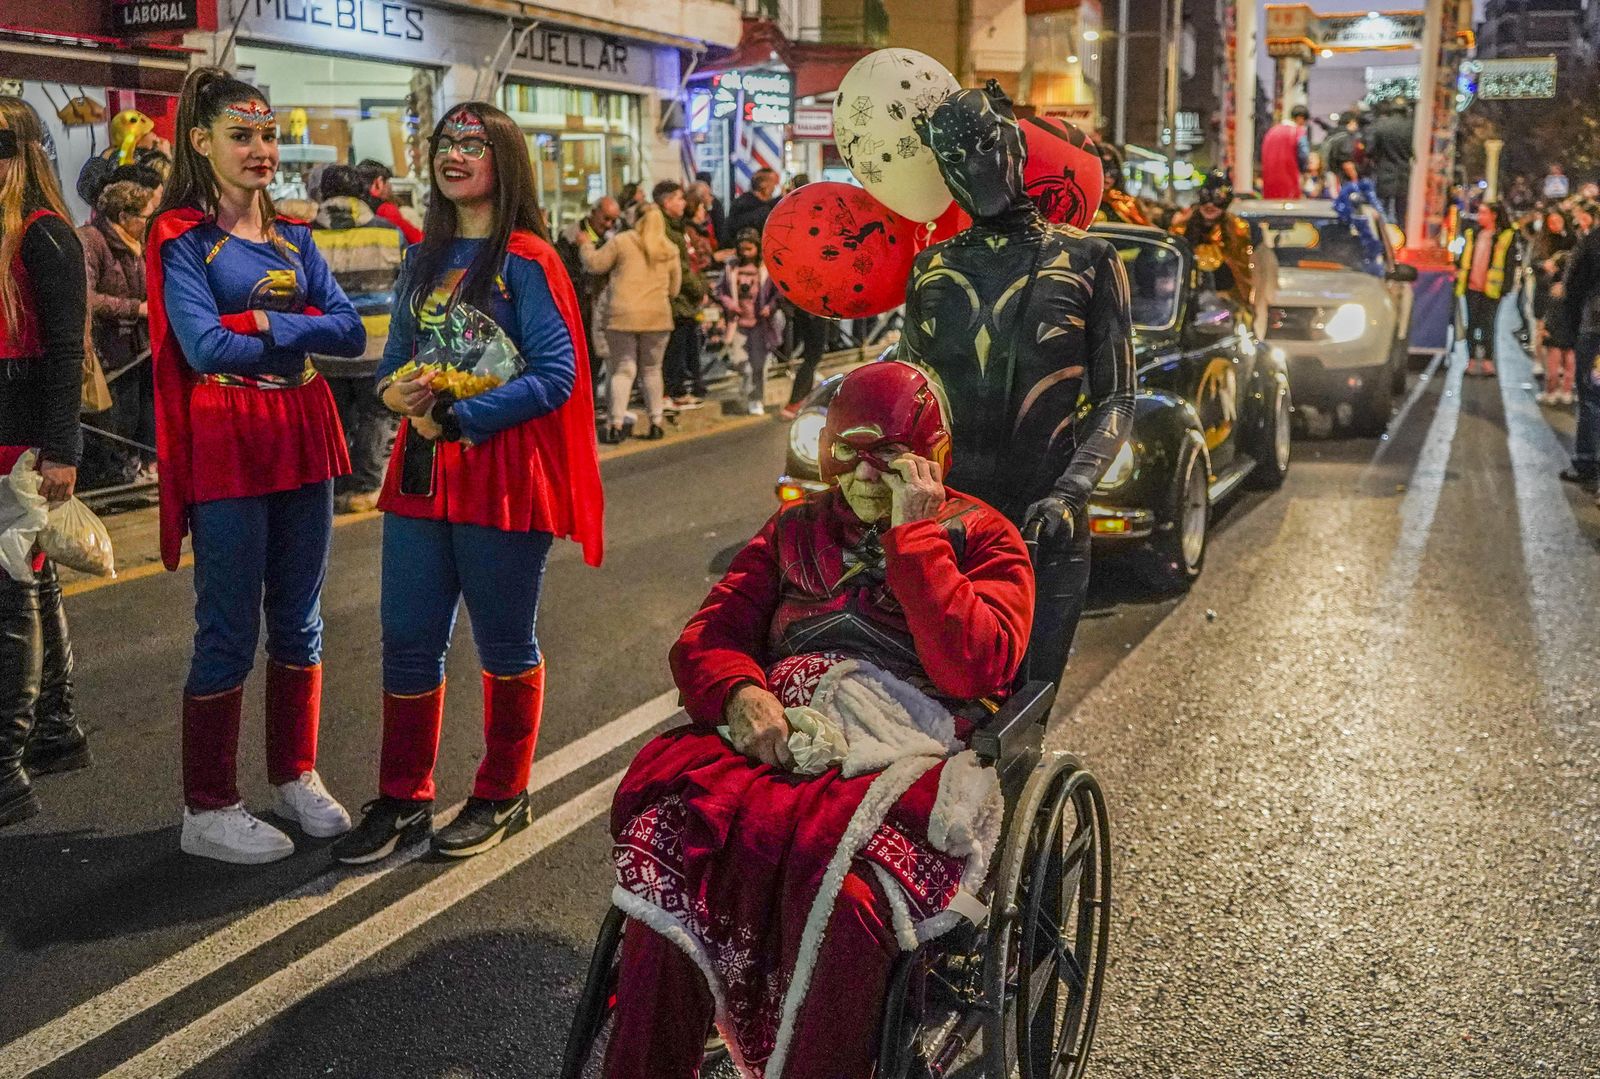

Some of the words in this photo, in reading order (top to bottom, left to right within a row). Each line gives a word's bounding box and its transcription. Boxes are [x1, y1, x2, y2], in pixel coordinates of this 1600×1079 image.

[124, 2, 187, 25] LABORAL
[255, 0, 424, 41] MUEBLES
[510, 26, 628, 74] CUELLAR
